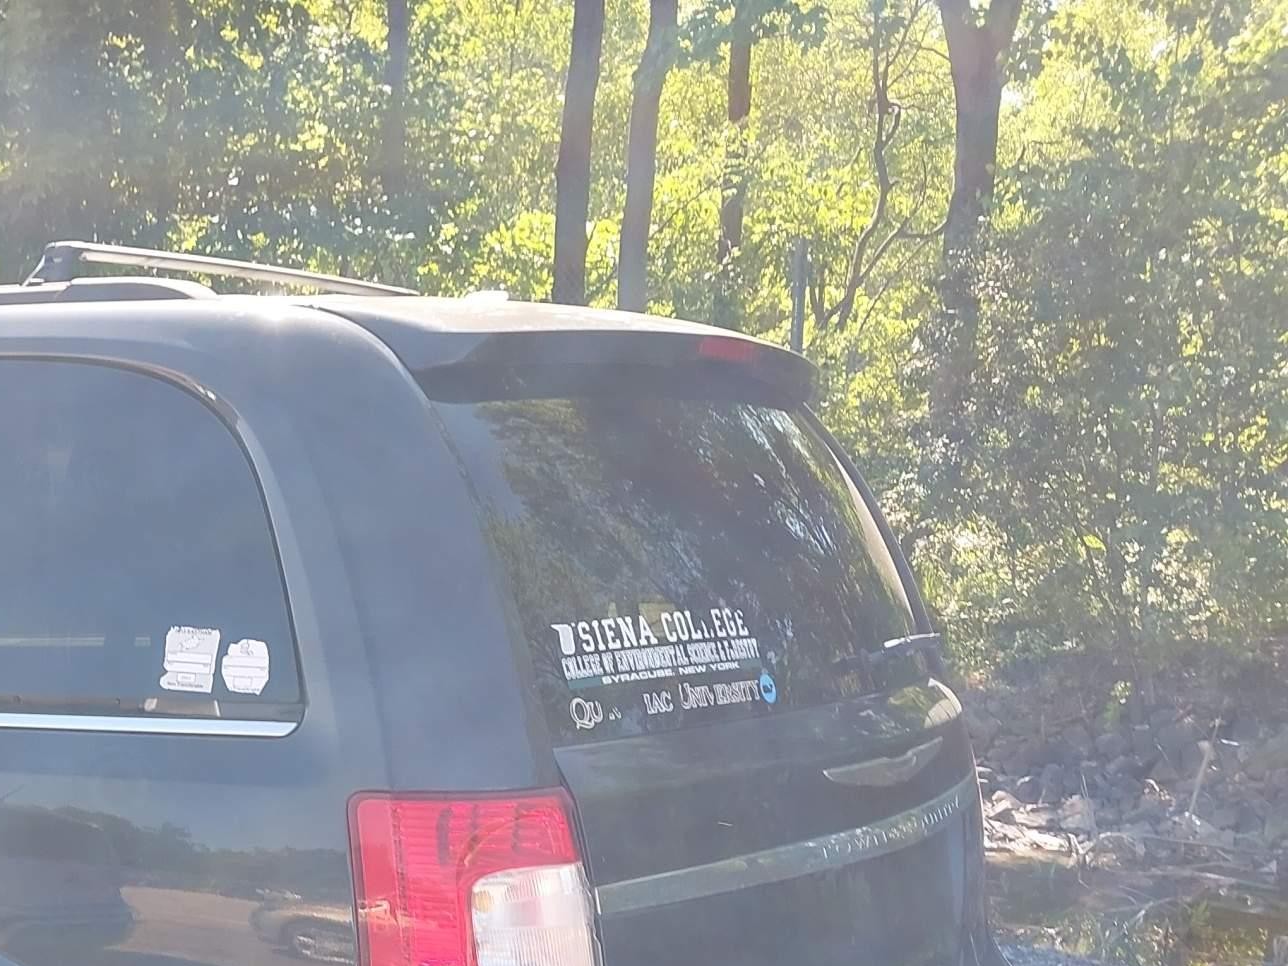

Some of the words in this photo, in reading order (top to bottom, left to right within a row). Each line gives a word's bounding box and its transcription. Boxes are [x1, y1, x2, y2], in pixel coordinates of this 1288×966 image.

[577, 614, 659, 653] SIENA
[561, 653, 605, 681] COLLEGE
[602, 651, 616, 674] OF
[679, 664, 706, 675] NEW
[710, 661, 740, 671] YORK
